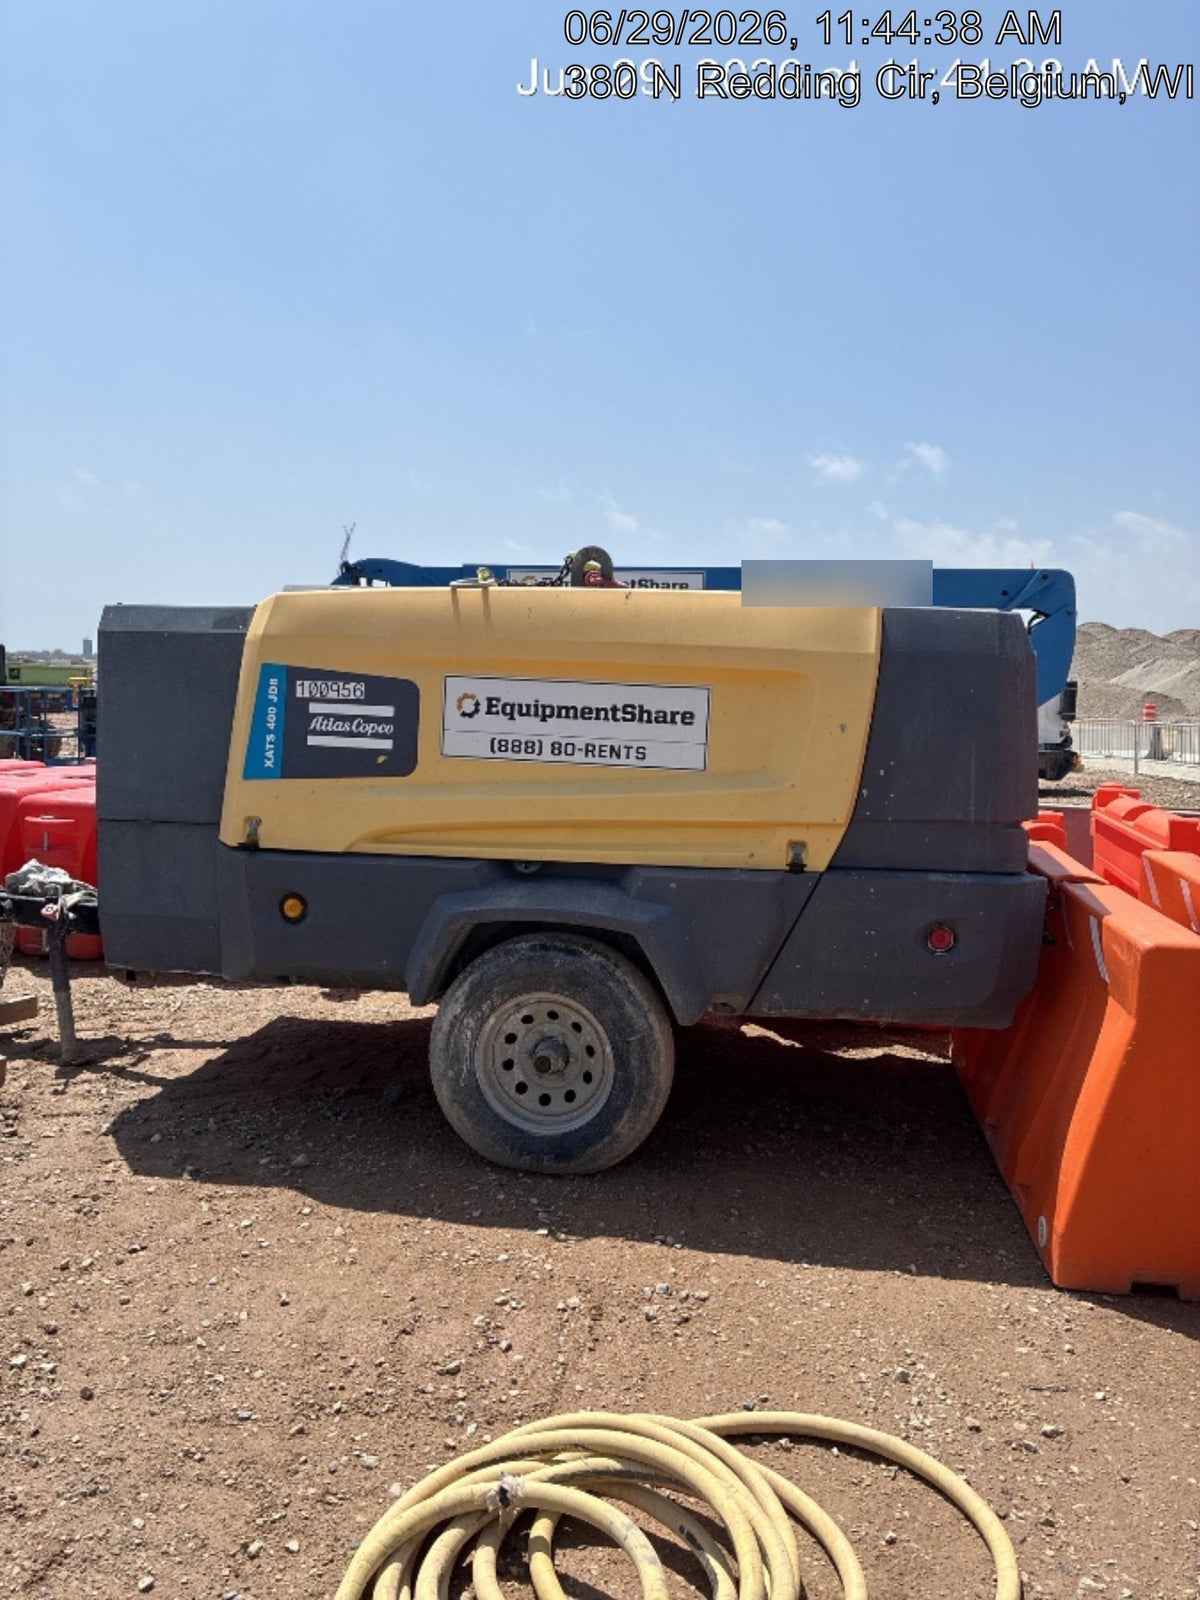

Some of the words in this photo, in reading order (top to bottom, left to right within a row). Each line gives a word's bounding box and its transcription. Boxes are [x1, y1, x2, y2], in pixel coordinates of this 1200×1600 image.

[297, 681, 365, 699] 100956
[266, 707, 278, 730] 400
[485, 696, 695, 726] EquipmentShare
[264, 734, 276, 768] XATS
[490, 737, 543, 756] (888)
[550, 741, 647, 760] 80-RENTS
